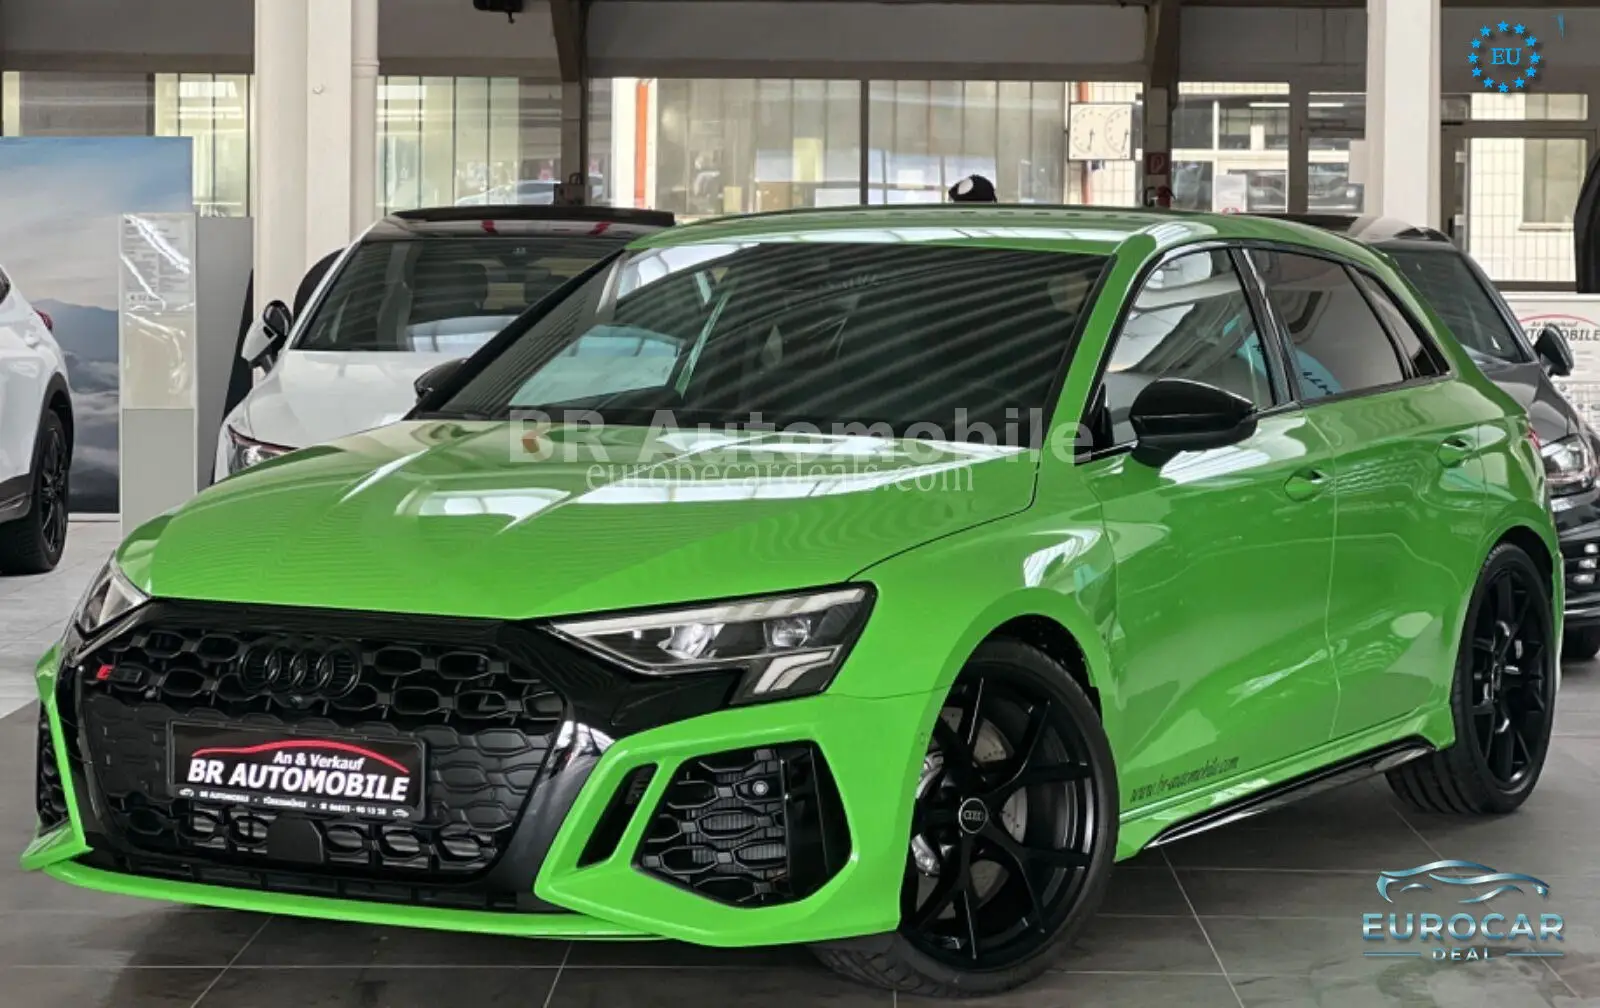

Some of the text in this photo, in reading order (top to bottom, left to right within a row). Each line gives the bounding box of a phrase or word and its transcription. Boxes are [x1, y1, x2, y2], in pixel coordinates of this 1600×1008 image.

[272, 750, 366, 772] An & Verkauf
[187, 758, 410, 802] BR AUTOMOBILE
